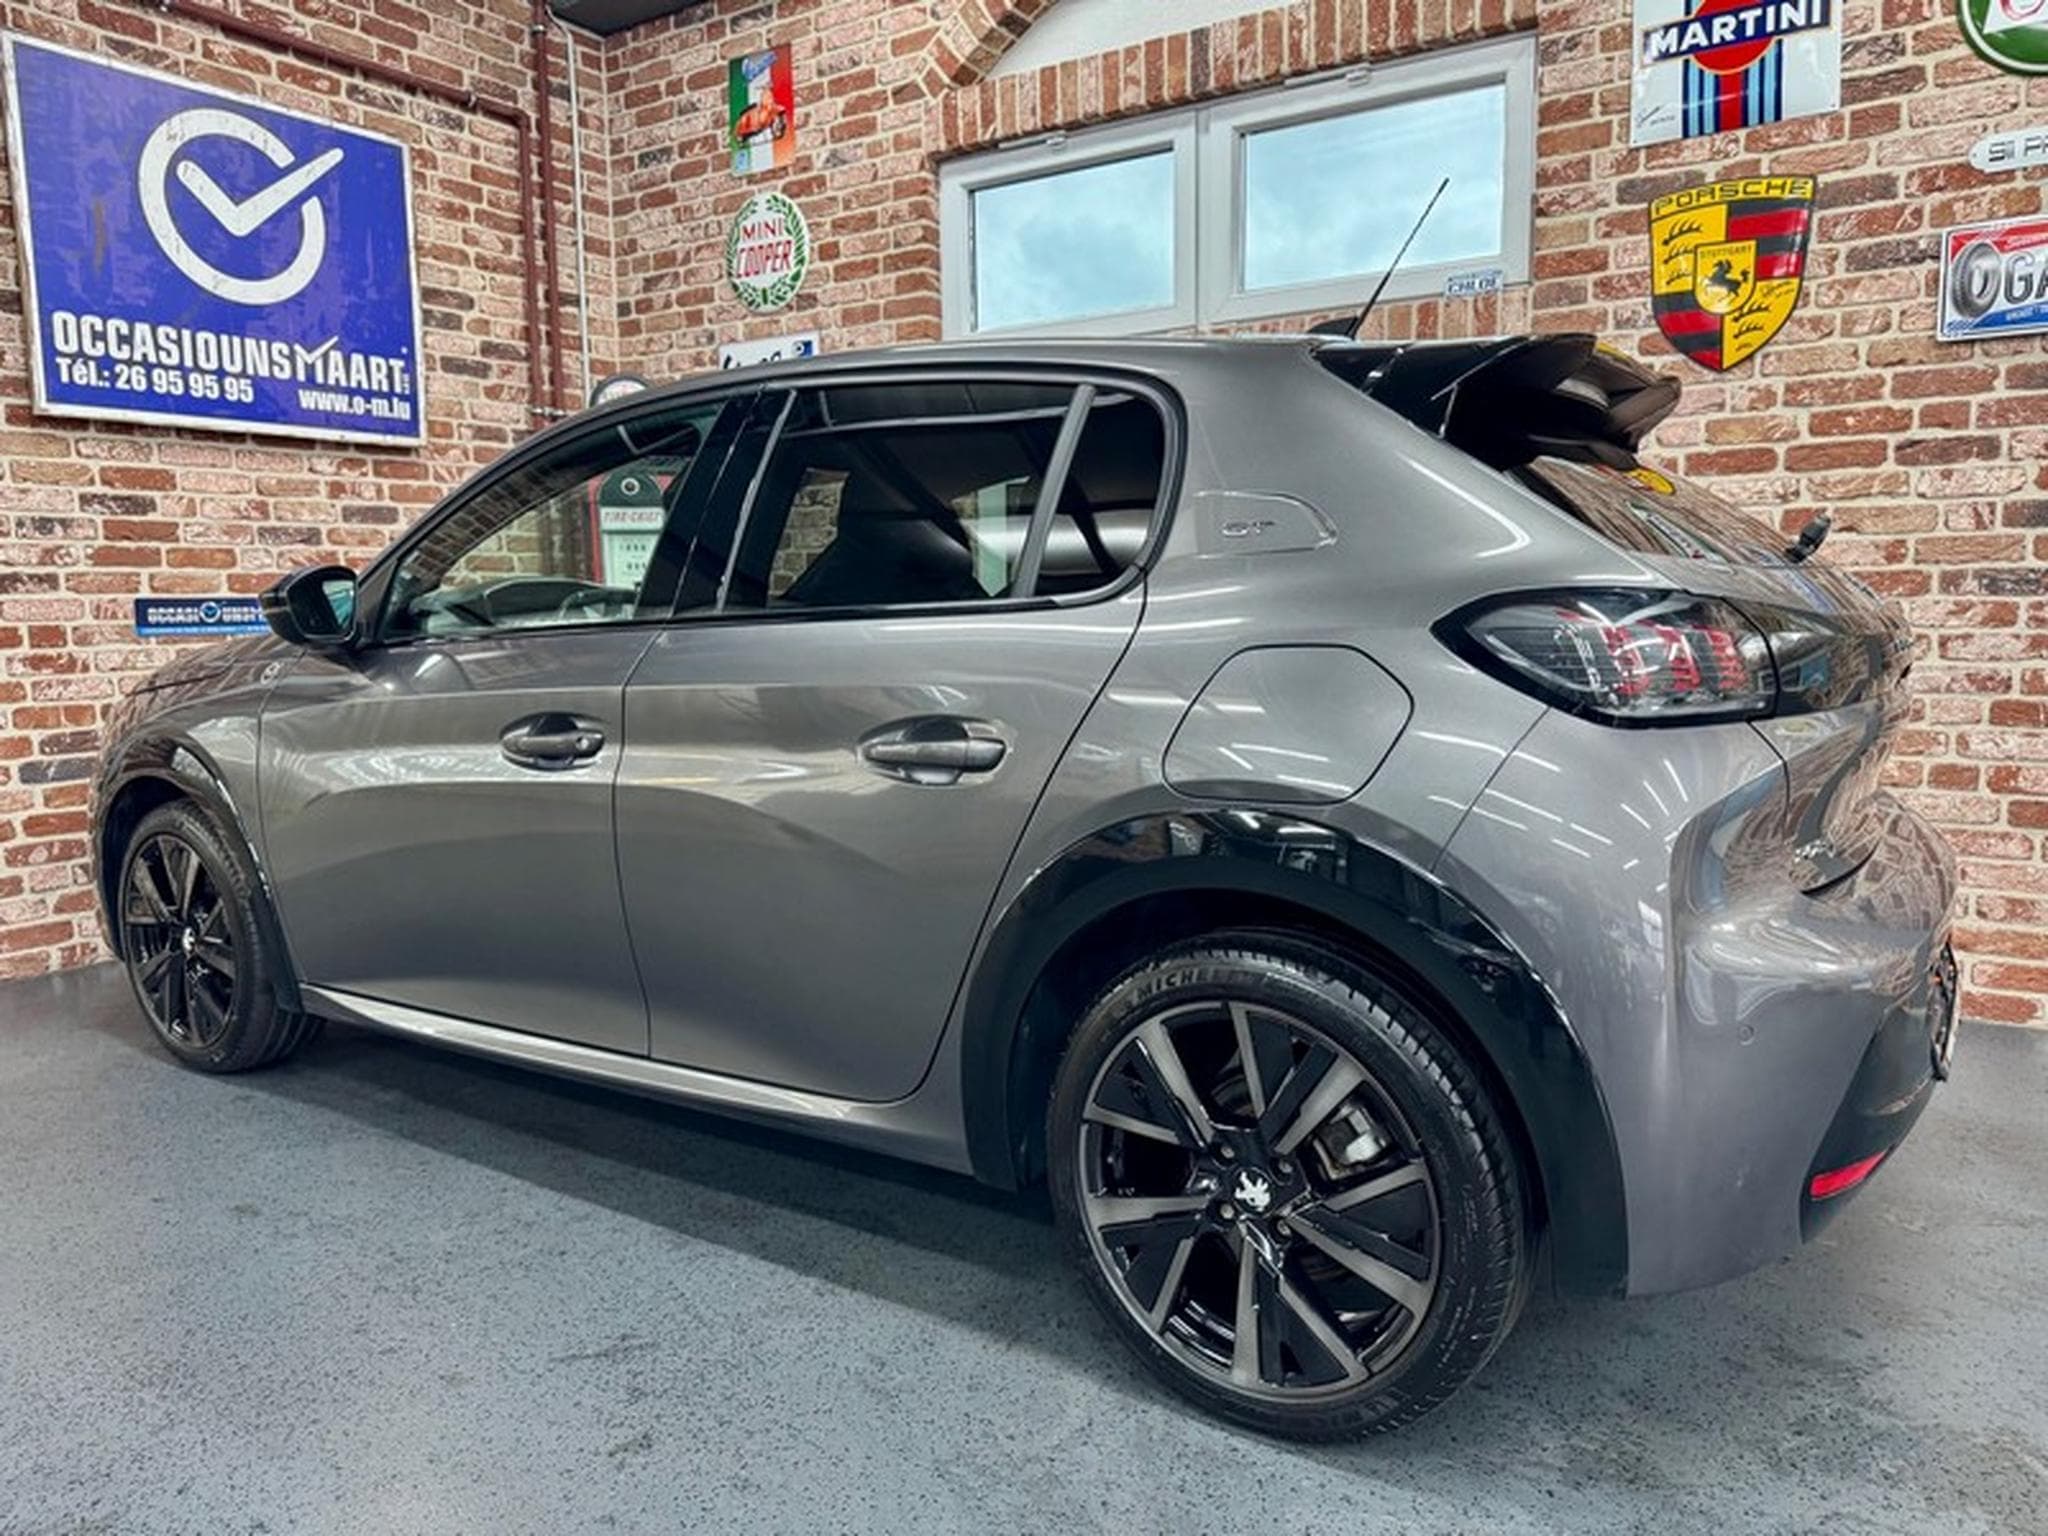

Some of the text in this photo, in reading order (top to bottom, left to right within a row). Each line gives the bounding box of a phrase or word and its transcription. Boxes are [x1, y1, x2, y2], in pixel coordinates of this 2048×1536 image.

[1645, 0, 1822, 62] MARTINI
[1655, 179, 1809, 215] PORSCHE
[741, 217, 783, 242] MINI
[736, 240, 792, 278] COOPER
[114, 363, 148, 392] 26
[151, 367, 184, 396] 95
[188, 372, 220, 400] 95
[223, 376, 254, 403] 95
[298, 388, 411, 420] www.o-m.lu
